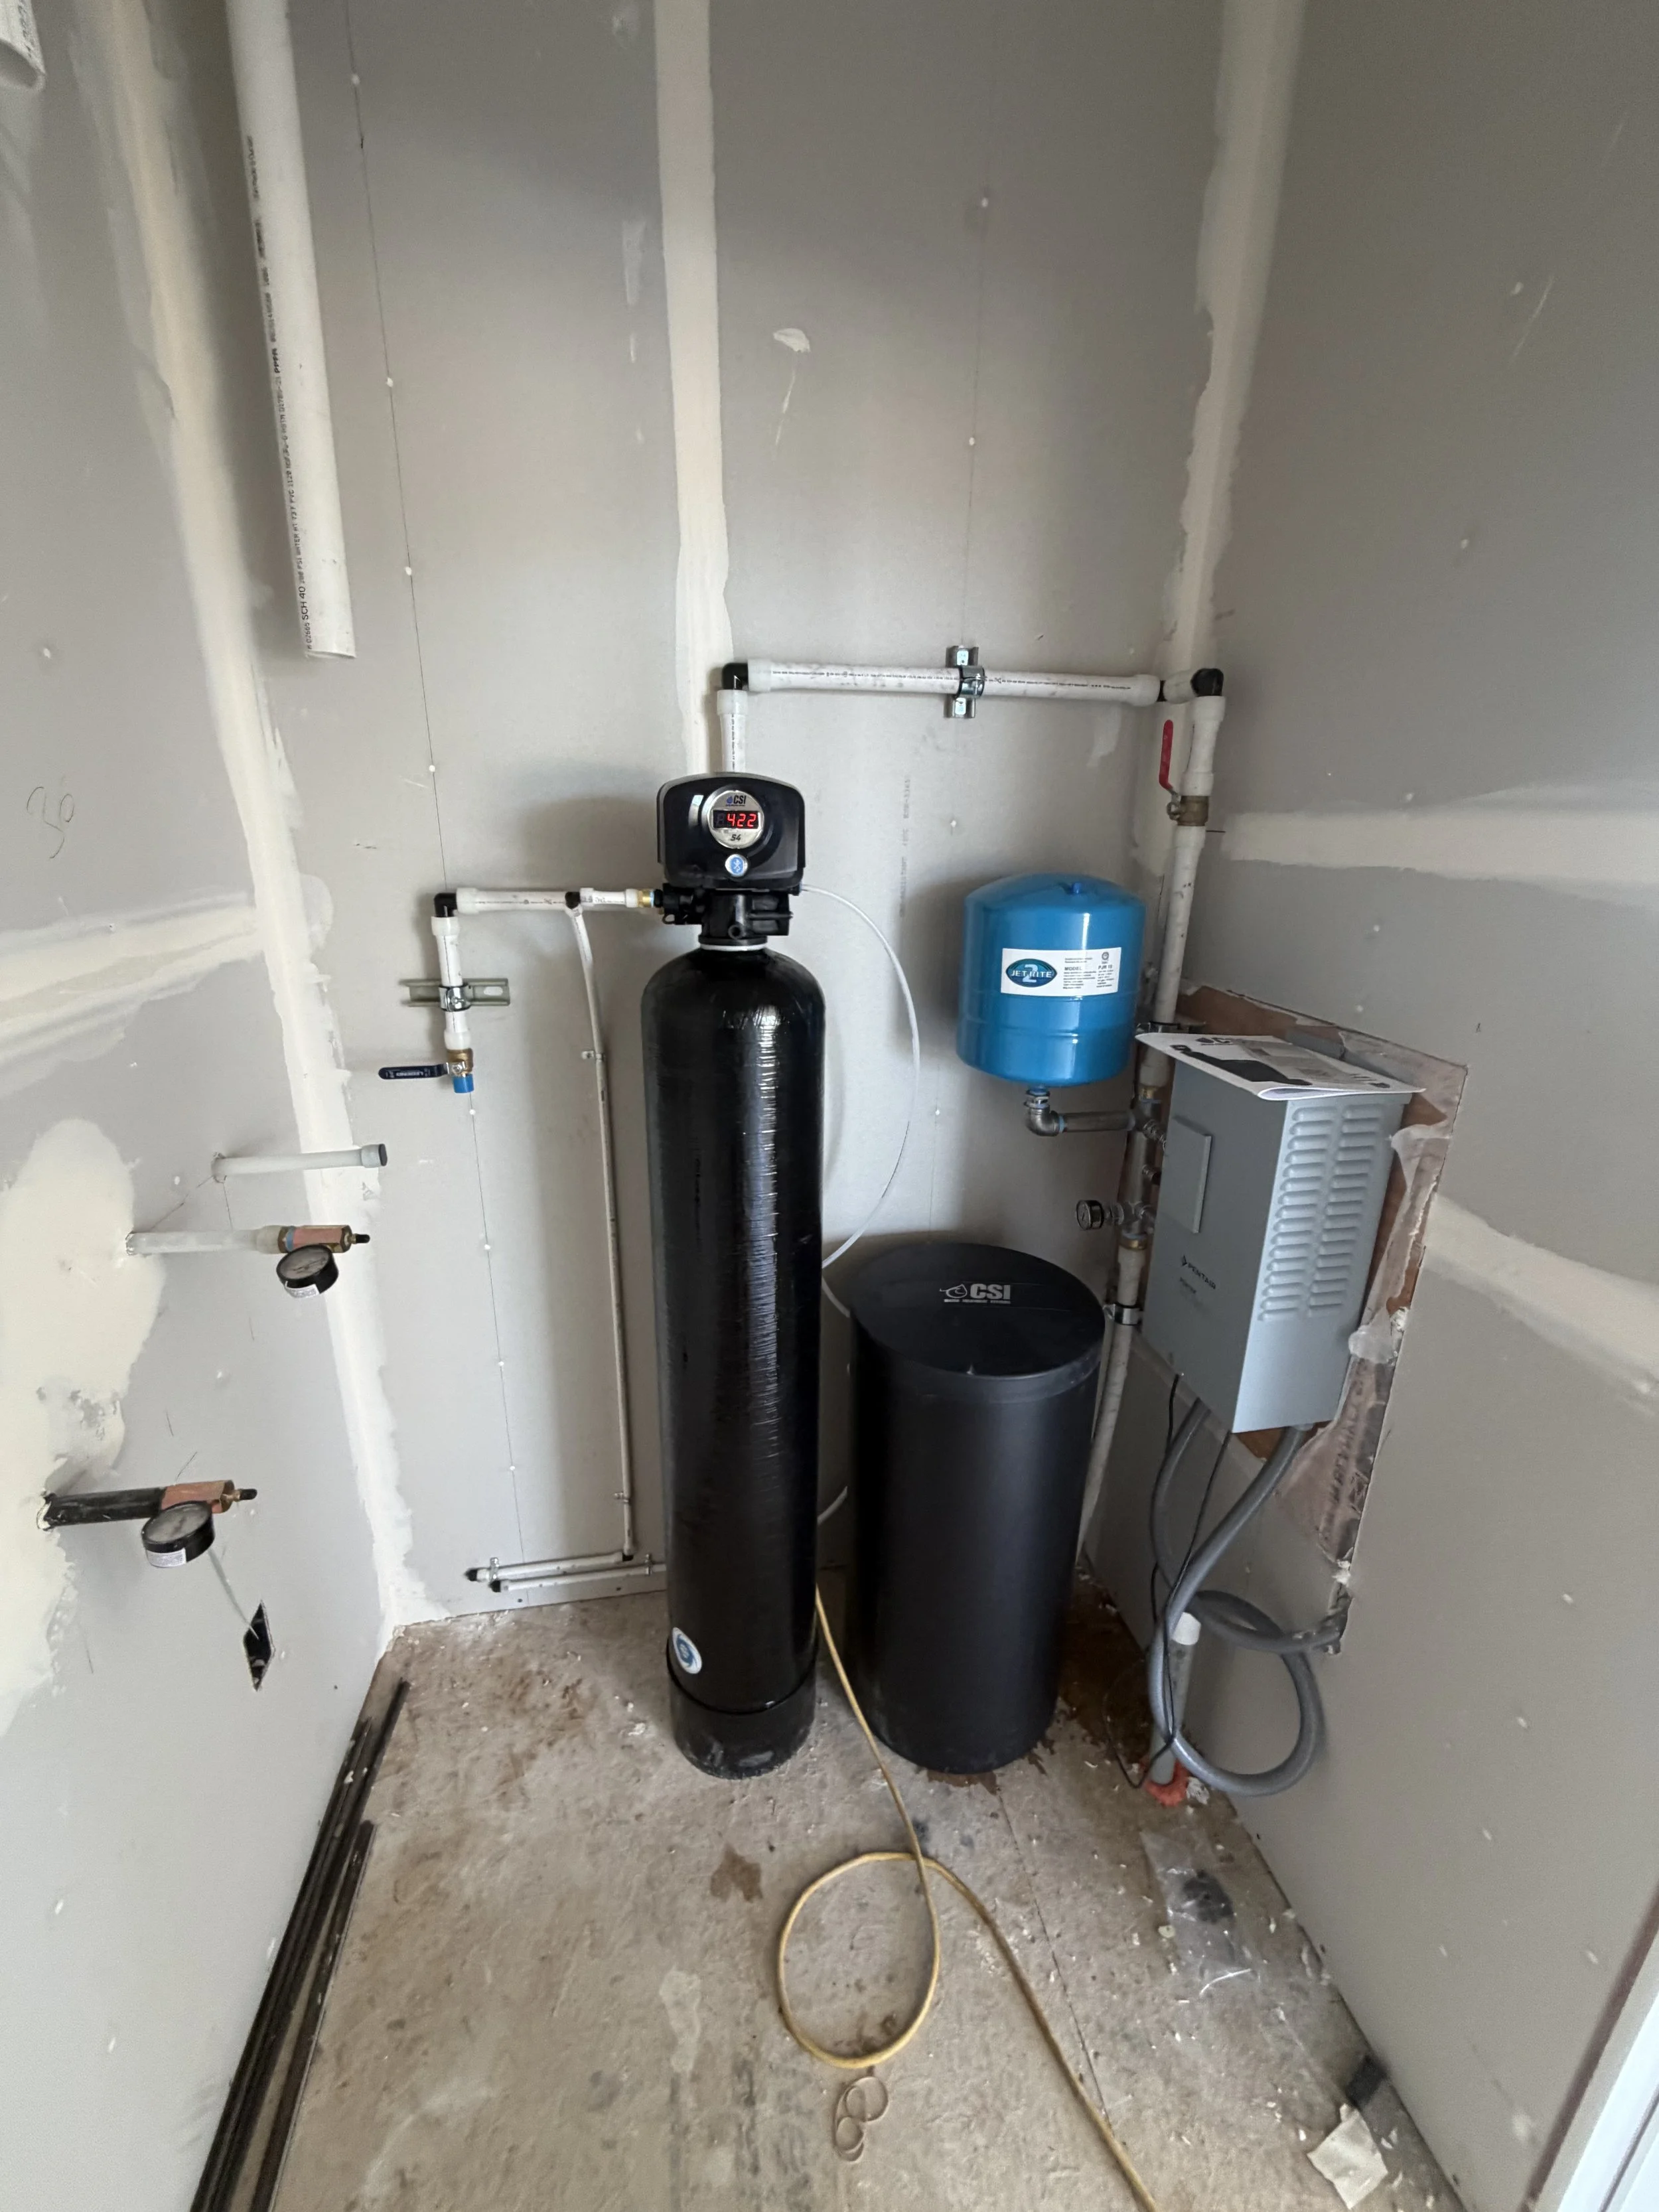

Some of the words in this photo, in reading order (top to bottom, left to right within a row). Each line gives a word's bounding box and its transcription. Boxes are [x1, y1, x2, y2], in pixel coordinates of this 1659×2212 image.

[299, 585, 306, 599] 40
[733, 795, 747, 804] CSI
[727, 813, 757, 828] 422
[1022, 964, 1038, 983] 2
[970, 1283, 1011, 1299] CSI
